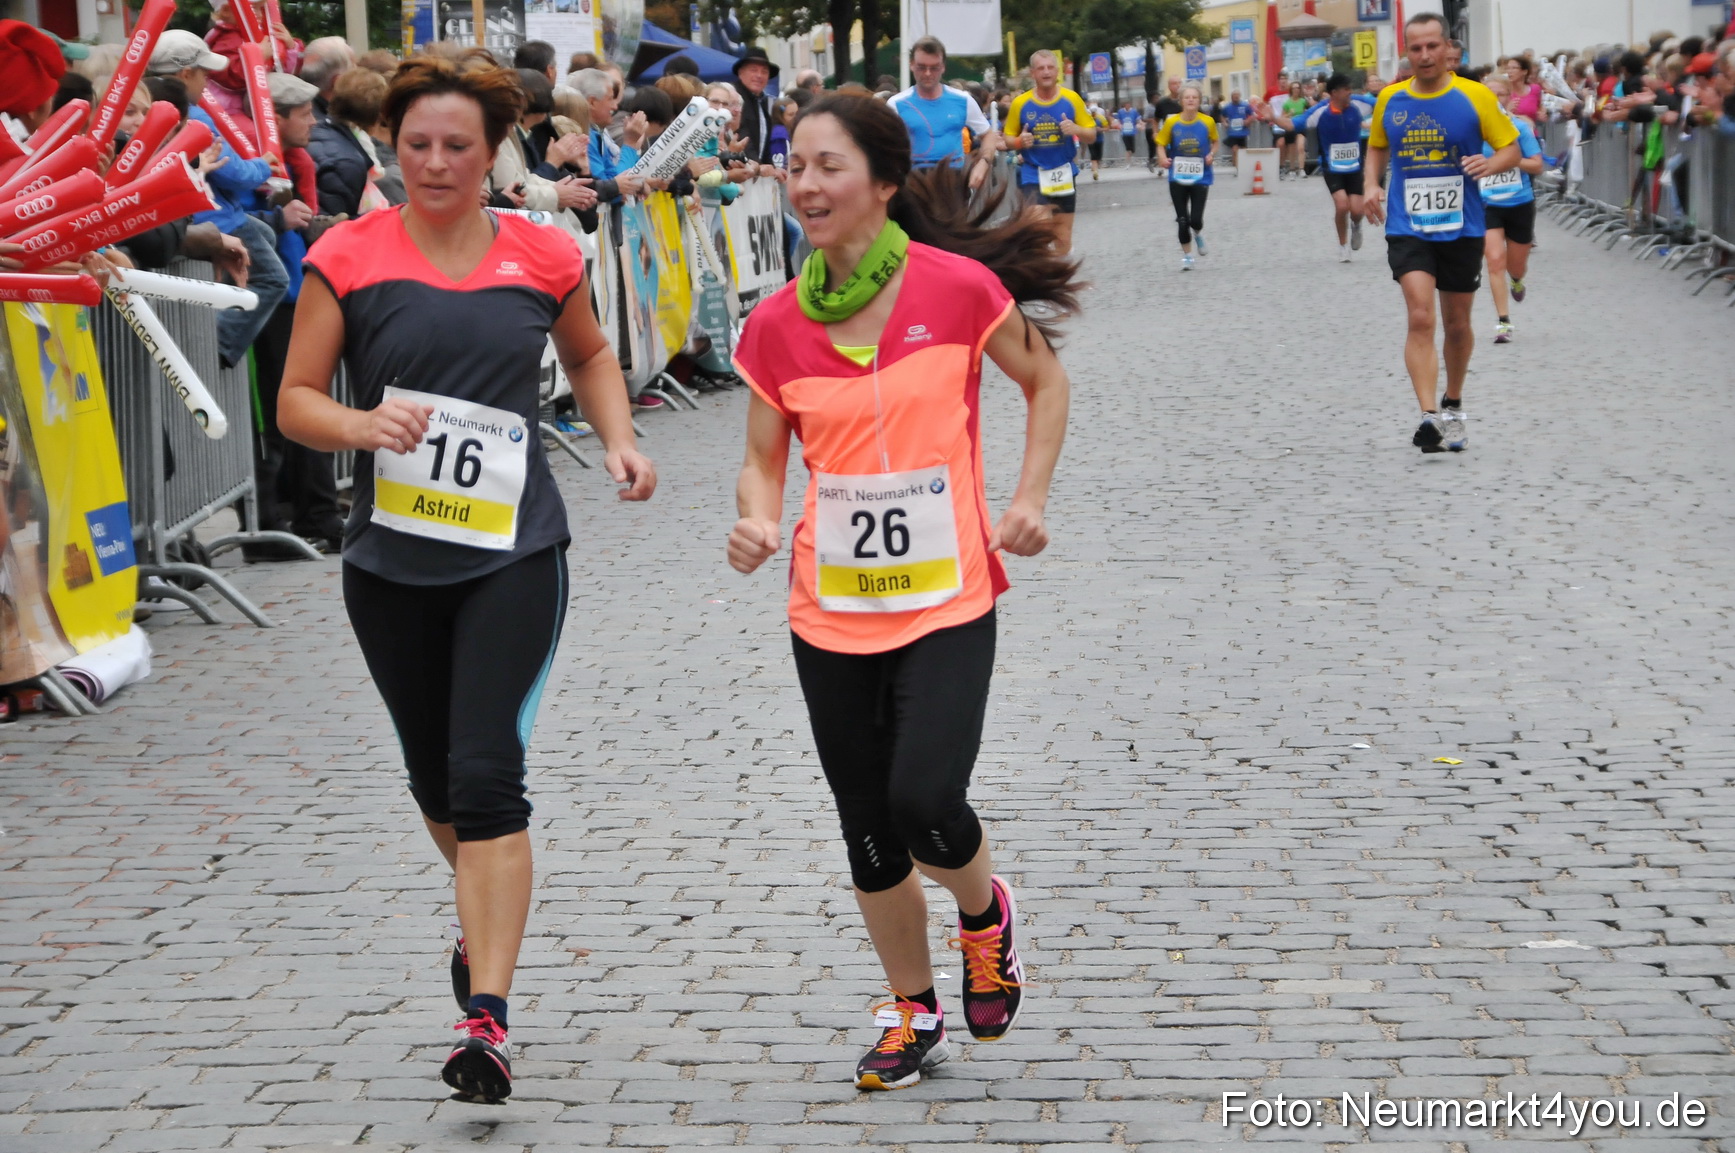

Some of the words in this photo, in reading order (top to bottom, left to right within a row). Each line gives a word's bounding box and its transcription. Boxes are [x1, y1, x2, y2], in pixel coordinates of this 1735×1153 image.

[1361, 42, 1372, 58] D
[1188, 68, 1206, 76] TAXI
[92, 103, 117, 142] Audi
[106, 73, 129, 103] BKK
[261, 96, 273, 117] BKK
[235, 130, 256, 152] Audi
[265, 118, 279, 144] Audi
[660, 118, 686, 146] BMW
[681, 129, 702, 151] BMW
[691, 128, 714, 151] BMW
[1051, 171, 1063, 182] 42
[1177, 162, 1200, 173] 2705
[104, 191, 141, 215] Audi
[1411, 189, 1458, 212] 2152
[68, 208, 102, 231] BKK
[123, 209, 159, 232] Audi
[86, 222, 119, 245] BKK
[438, 410, 504, 437] Neumarkt
[426, 432, 484, 488] 16
[818, 486, 852, 501] PARTL
[855, 484, 924, 501] Neumarkt
[412, 494, 471, 523] Astrid
[851, 507, 910, 559] 26
[858, 573, 911, 593] Diana
